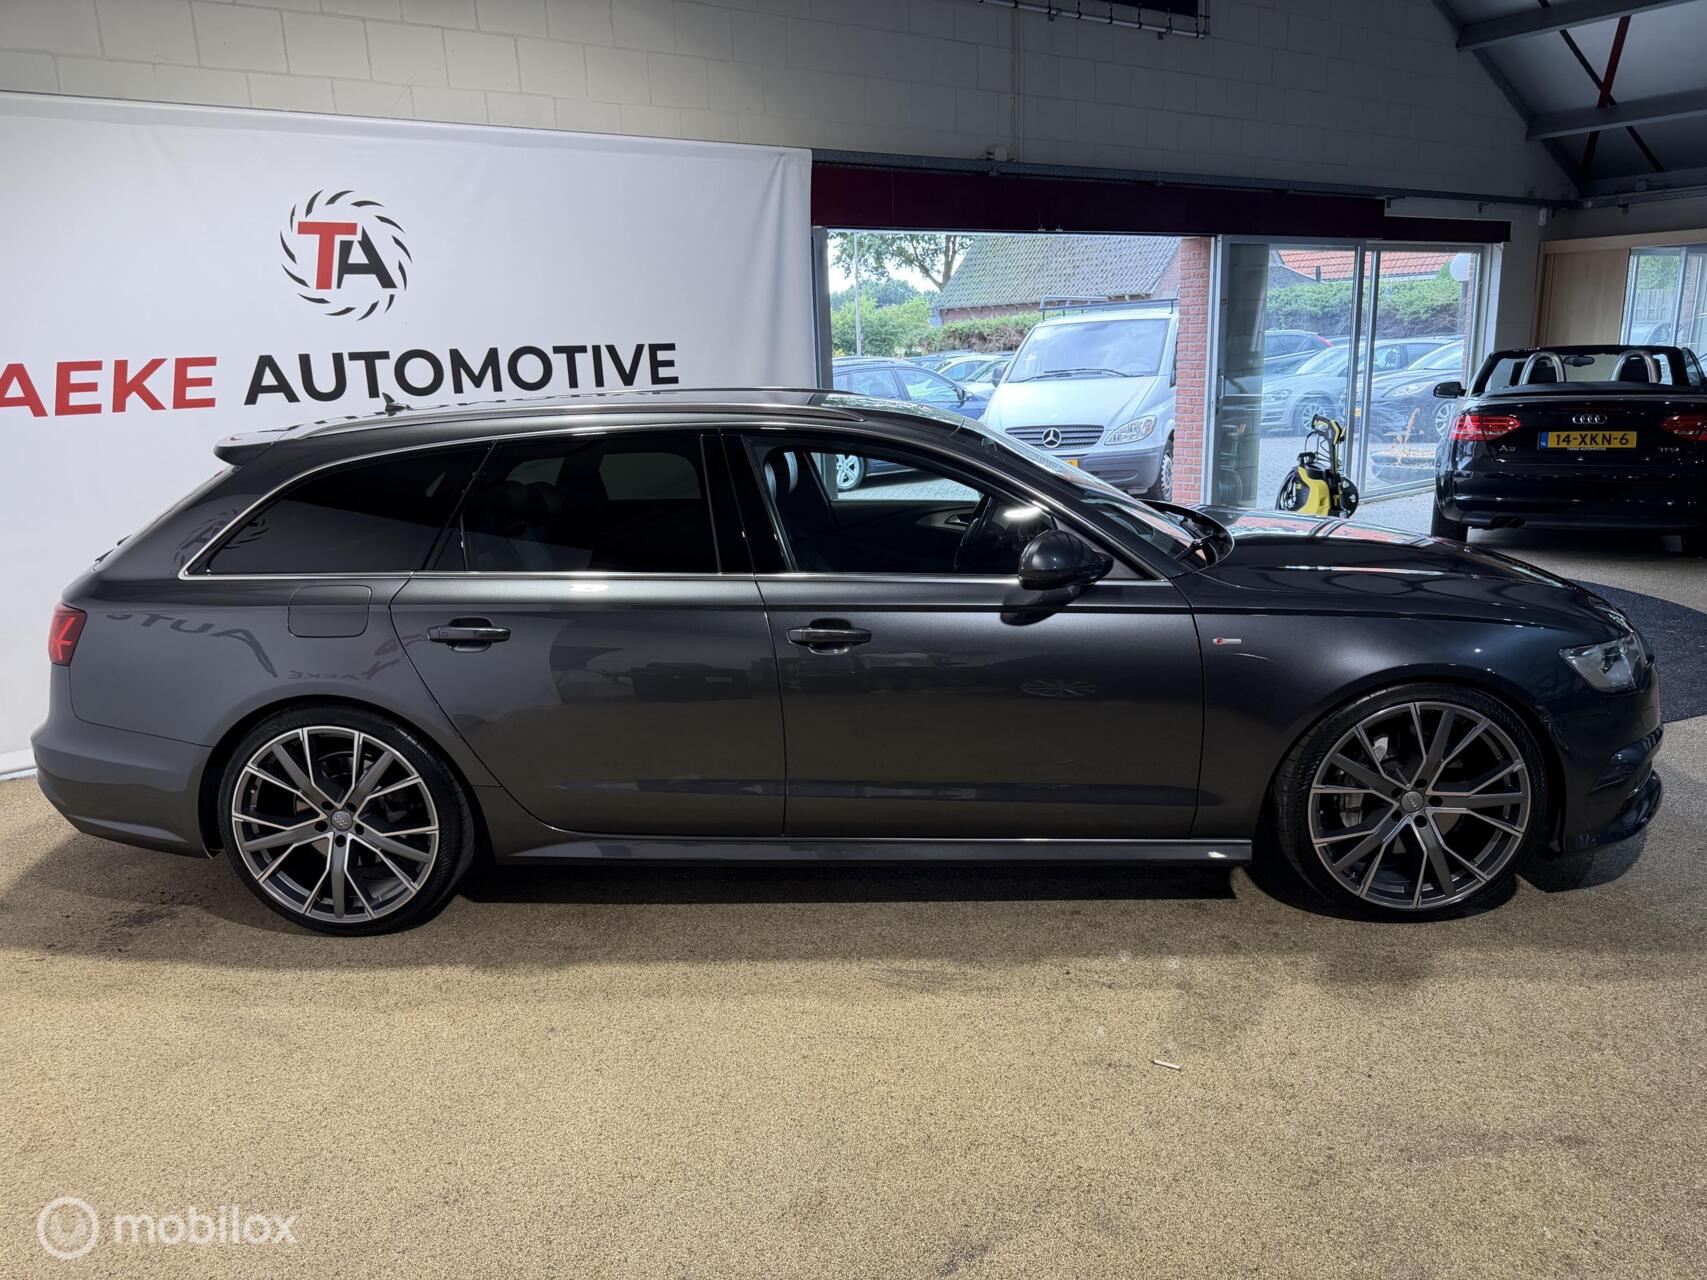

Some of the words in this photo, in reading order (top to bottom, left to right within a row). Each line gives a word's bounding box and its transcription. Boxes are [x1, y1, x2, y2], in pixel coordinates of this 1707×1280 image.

[297, 221, 398, 290] TA
[0, 355, 217, 417] AEKE
[243, 342, 679, 405] AUTOMOTIVE
[1555, 433, 1629, 446] 14-XKN-6
